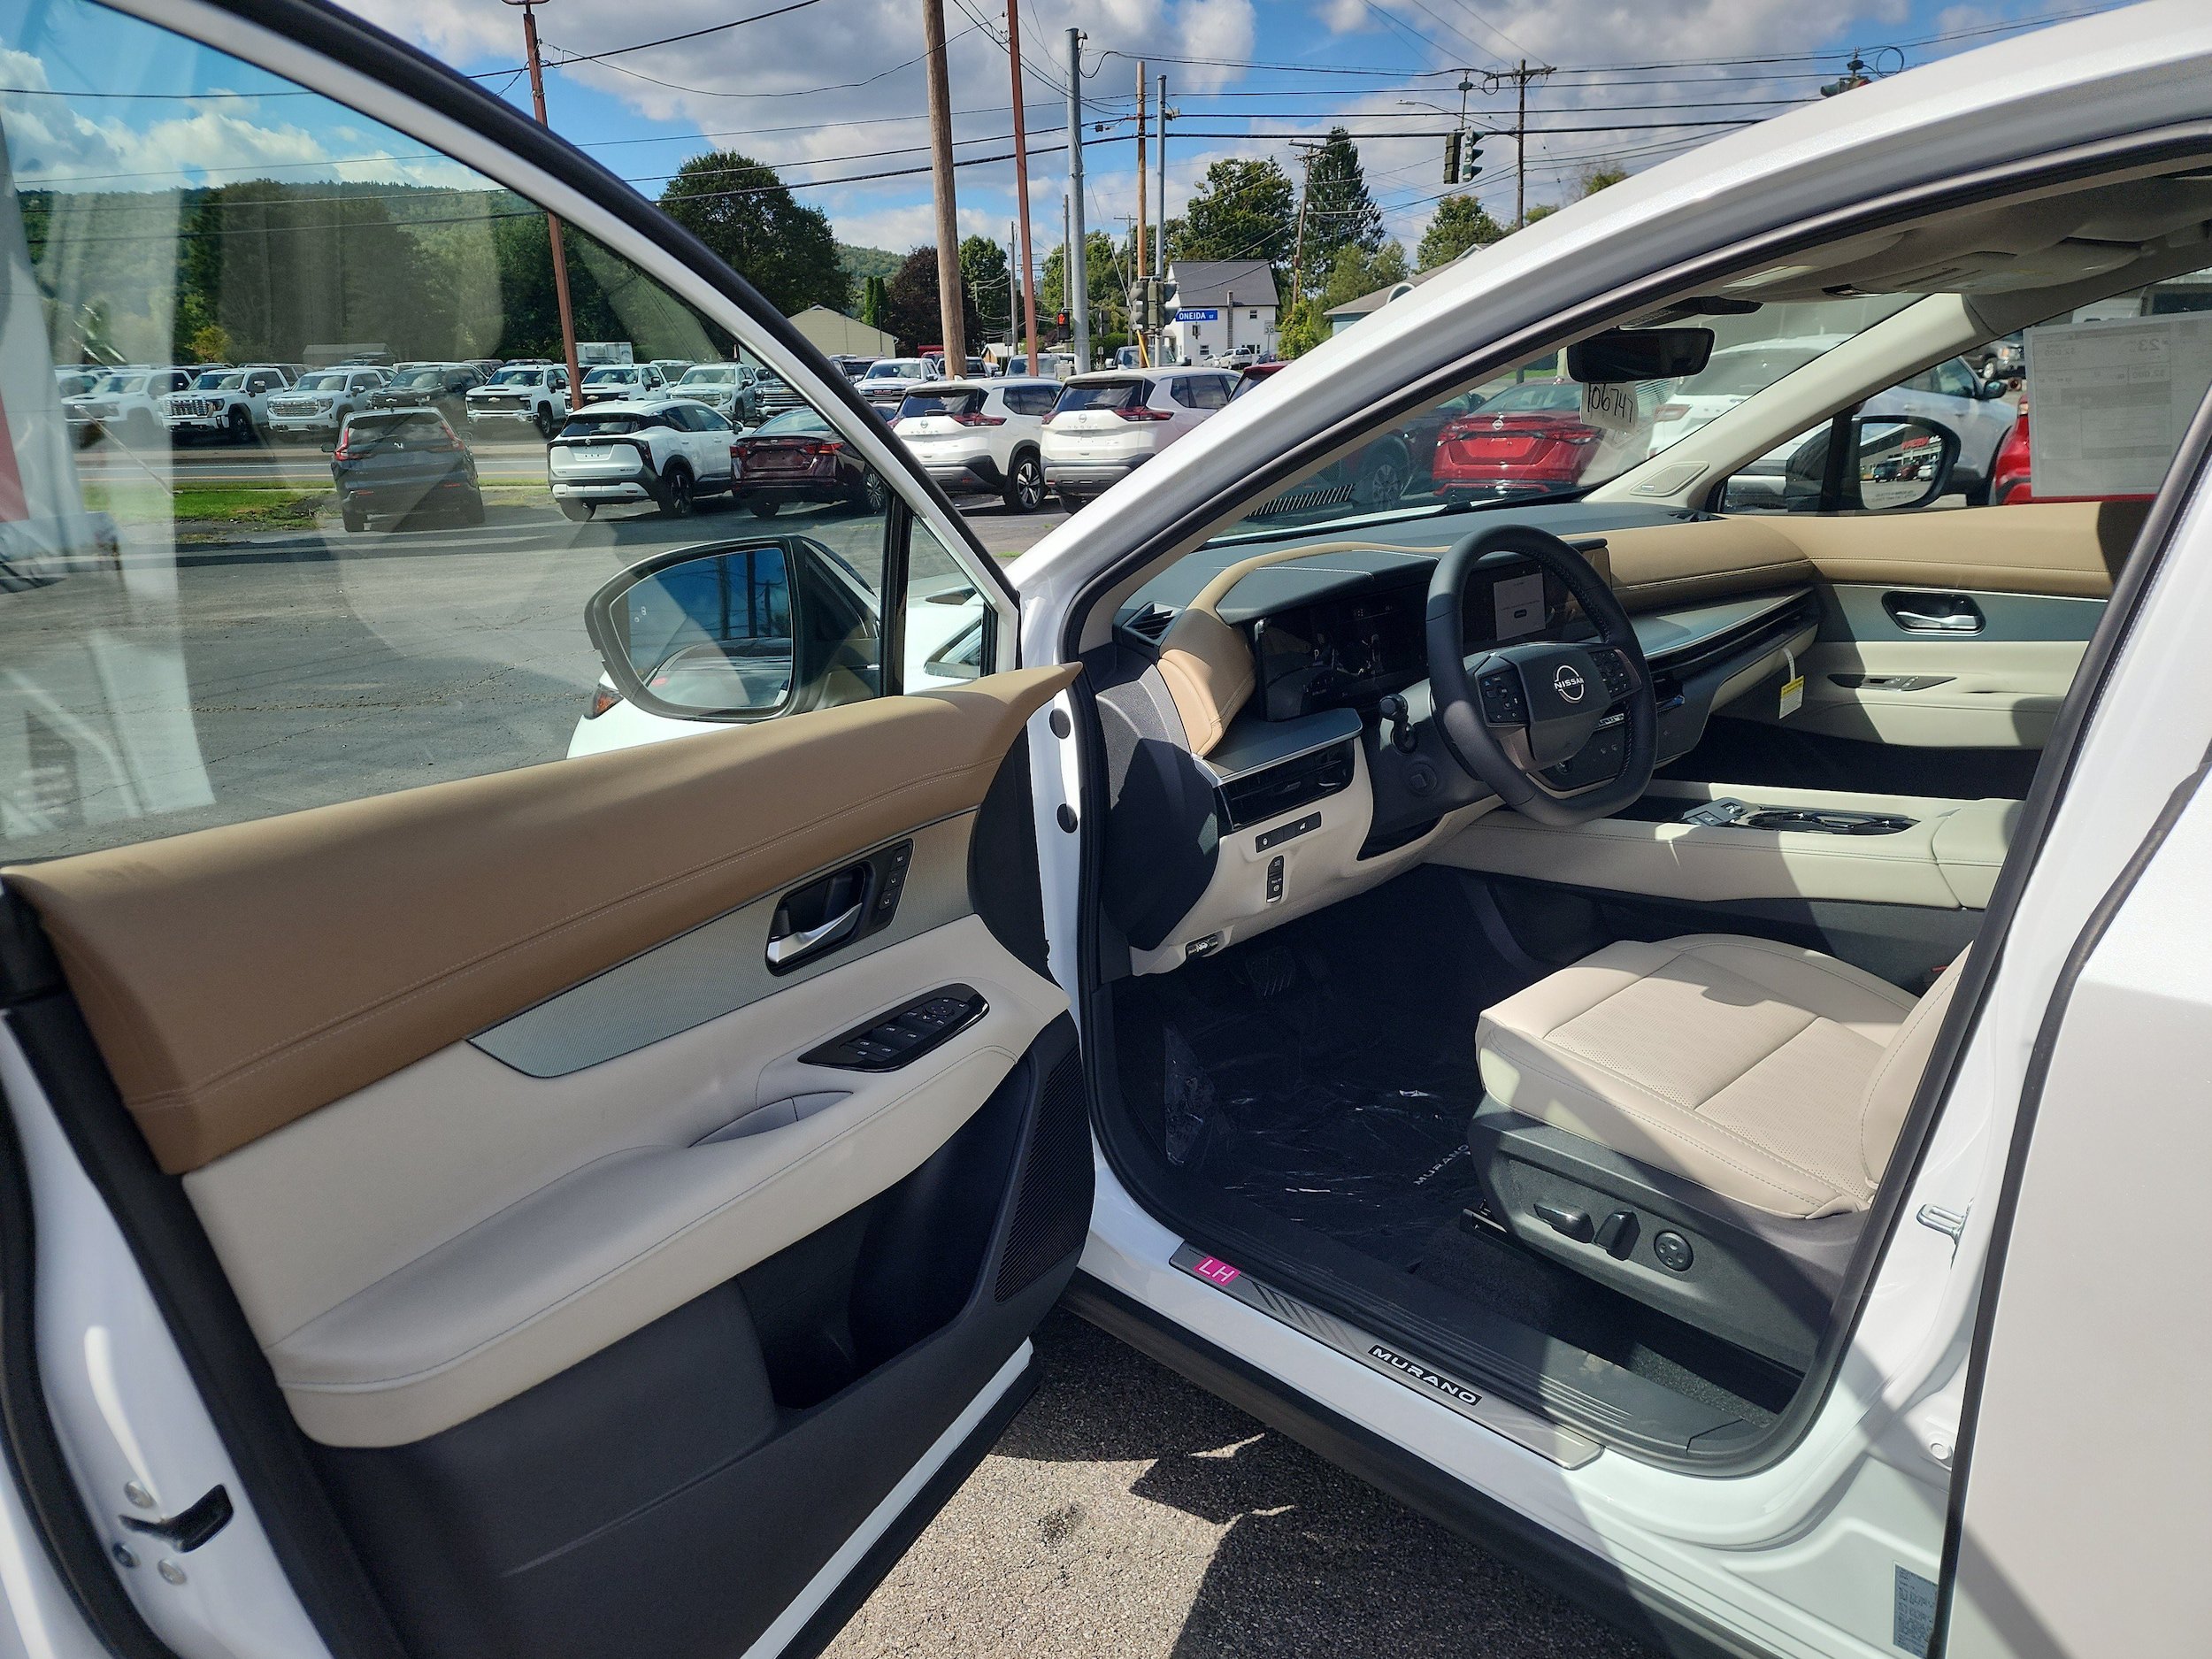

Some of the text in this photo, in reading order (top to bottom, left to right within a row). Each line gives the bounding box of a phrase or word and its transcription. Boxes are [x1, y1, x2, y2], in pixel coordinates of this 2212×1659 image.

[1179, 311, 1207, 320] ONEIDA
[1587, 383, 1633, 424] 106747
[1554, 677, 1585, 690] NISSAN
[1413, 1144, 1470, 1186] MURANO
[1198, 1259, 1235, 1282] LH
[1372, 1348, 1477, 1404] MURANO
